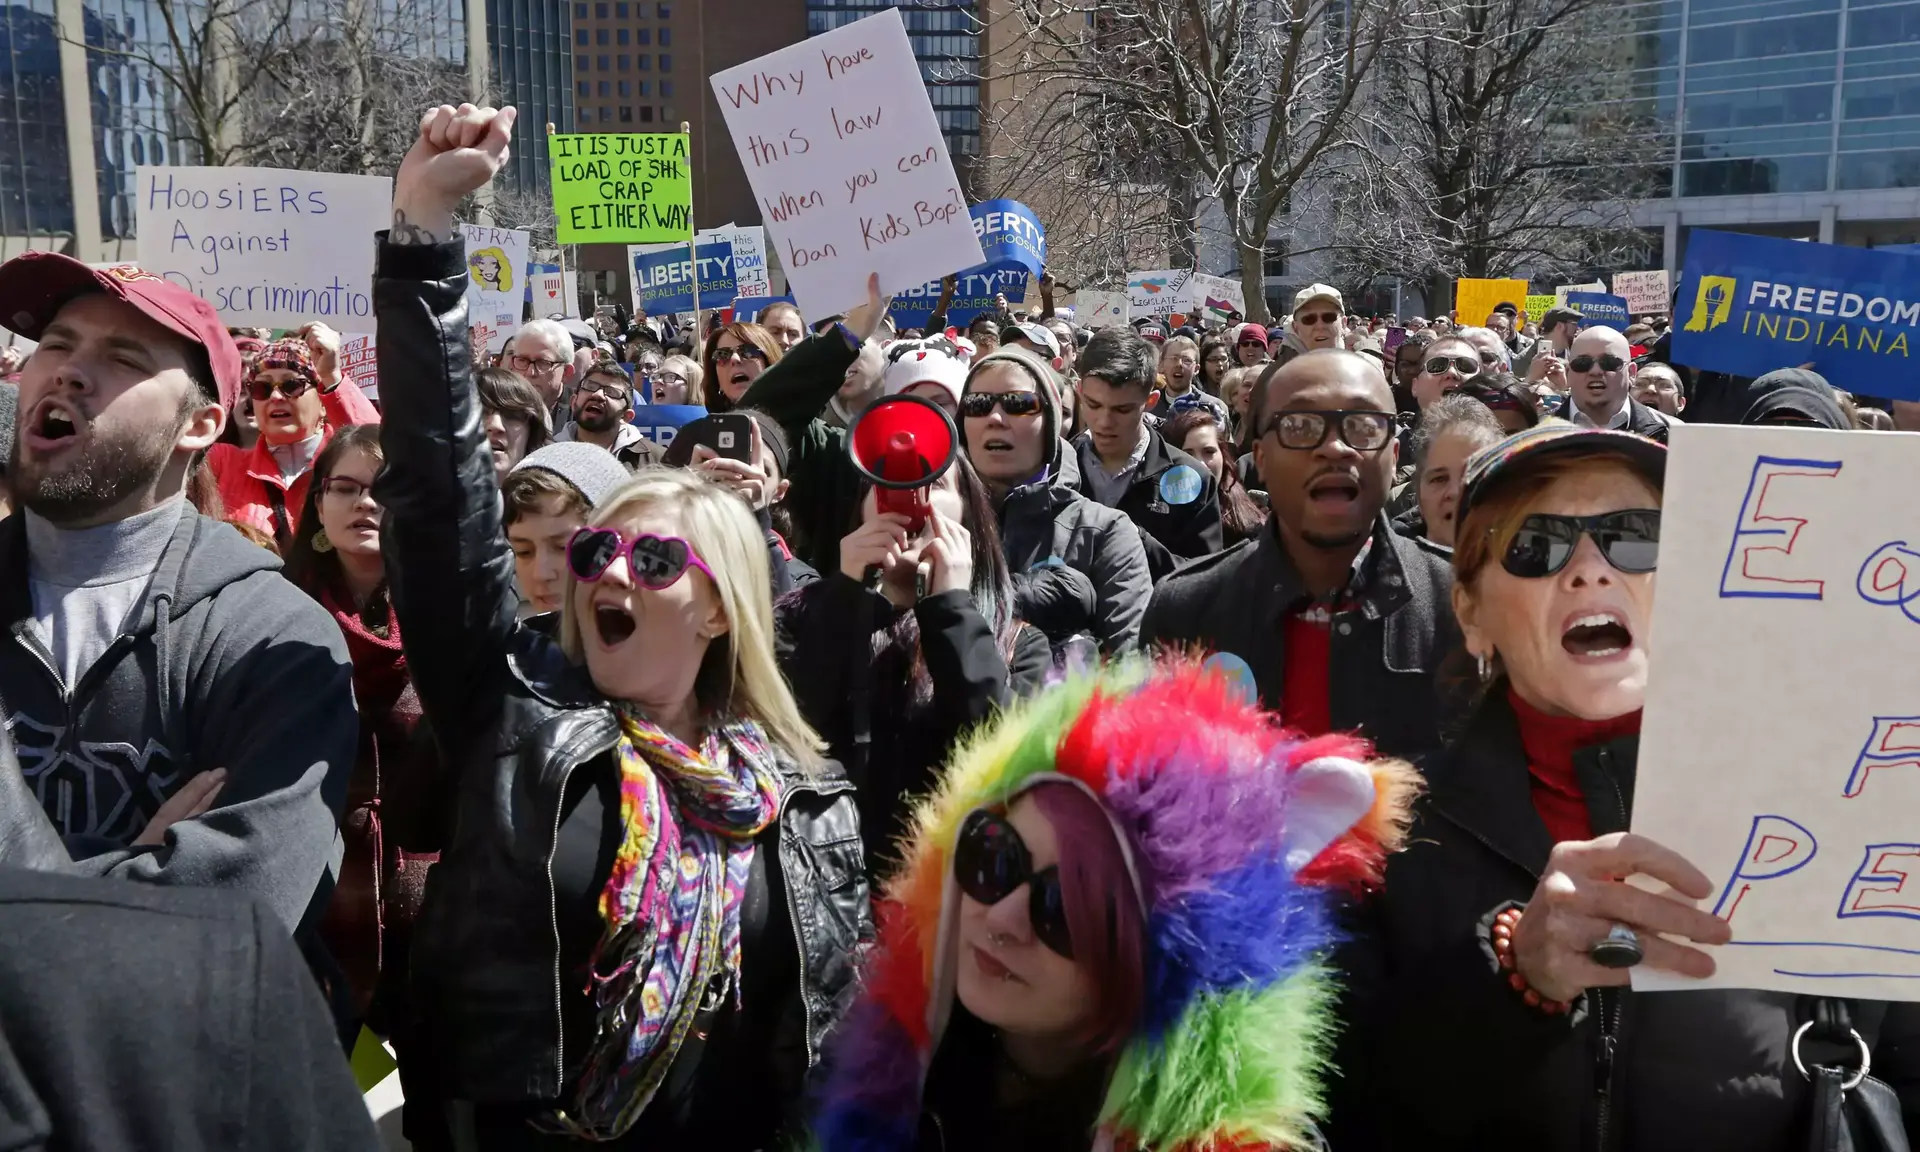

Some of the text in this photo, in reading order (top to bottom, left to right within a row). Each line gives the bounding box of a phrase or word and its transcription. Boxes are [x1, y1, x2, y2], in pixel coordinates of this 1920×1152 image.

[721, 47, 874, 109] Why have
[556, 136, 686, 158] IT IS JUST A
[748, 105, 882, 167] this law
[560, 159, 611, 182] LOAD
[619, 160, 642, 178] OF
[845, 168, 878, 204] you
[897, 146, 938, 172] can
[599, 181, 653, 201] CRAP
[570, 203, 691, 231] EITHER WAY
[465, 225, 516, 246] RFRA
[733, 234, 753, 245] this
[788, 239, 838, 269] ban
[859, 213, 910, 251] Kids
[971, 211, 1045, 251] BERTY
[170, 219, 290, 275] Against
[733, 246, 757, 256] about
[637, 255, 732, 289] LIBERTY
[753, 268, 763, 281] I
[163, 271, 371, 318] iscriminatio
[640, 288, 658, 301] FOR
[657, 285, 675, 298] ALL
[1628, 290, 1667, 302] vestment
[890, 298, 996, 311] OR ALL OOSIERS
[1153, 304, 1177, 314] HATE
[1582, 303, 1626, 314] FREEDOM
[1749, 281, 1920, 328] FREEDOM
[1583, 311, 1626, 321] NDIANA
[1741, 310, 1910, 358] INDIANA
[349, 351, 363, 363] NO
[365, 349, 375, 359] to
